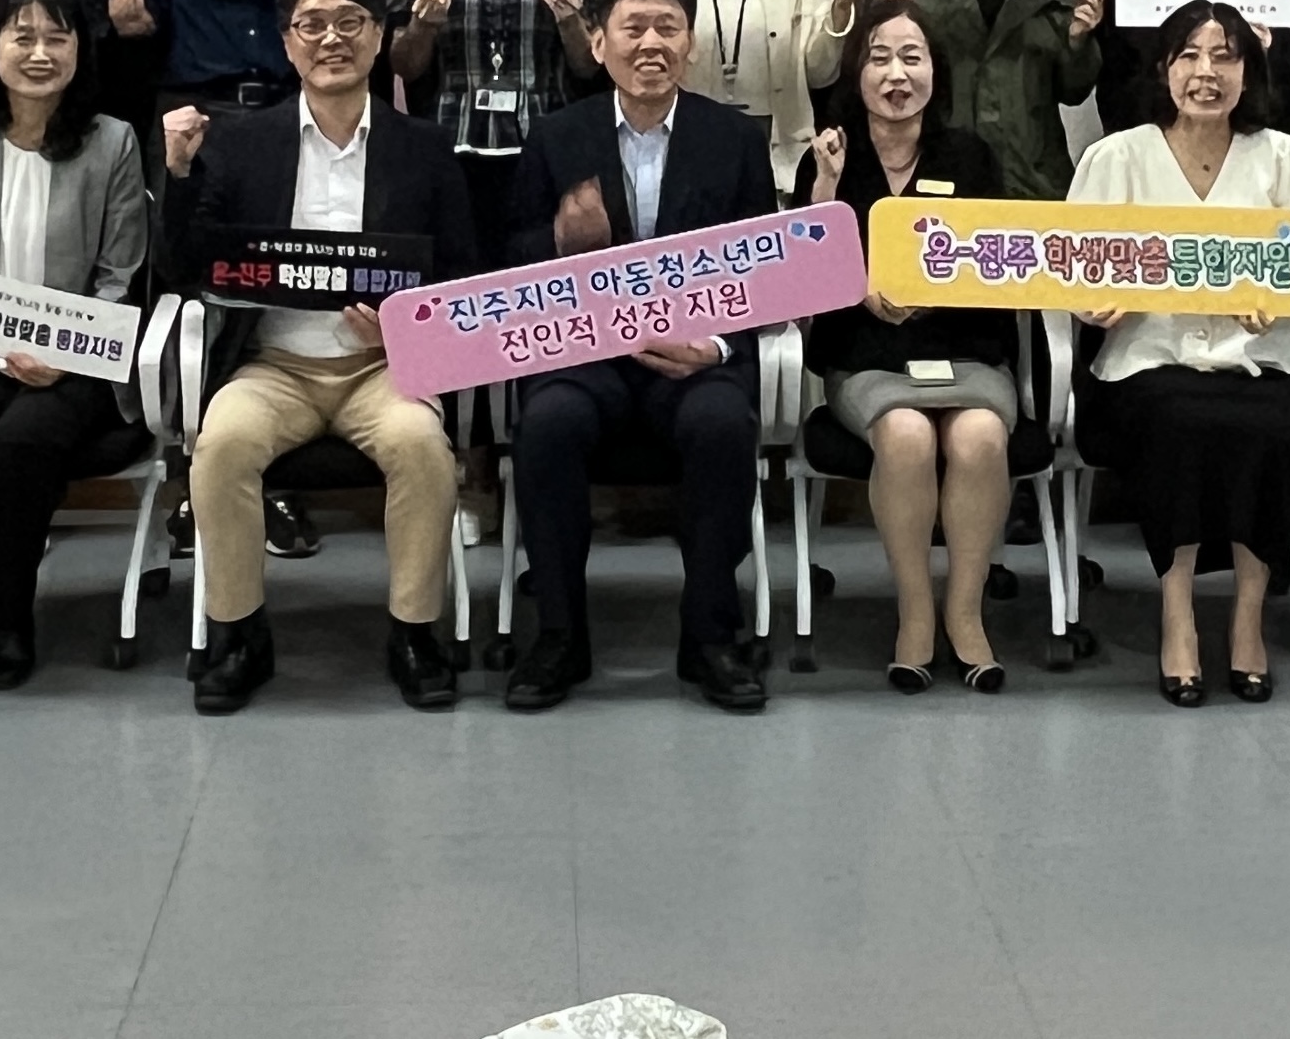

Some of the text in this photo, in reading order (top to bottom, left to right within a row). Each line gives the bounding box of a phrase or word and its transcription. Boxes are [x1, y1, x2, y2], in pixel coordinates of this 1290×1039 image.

[447, 232, 785, 333] 진주지역 아동청소년의
[501, 282, 751, 363] 전인적 성장 지원
